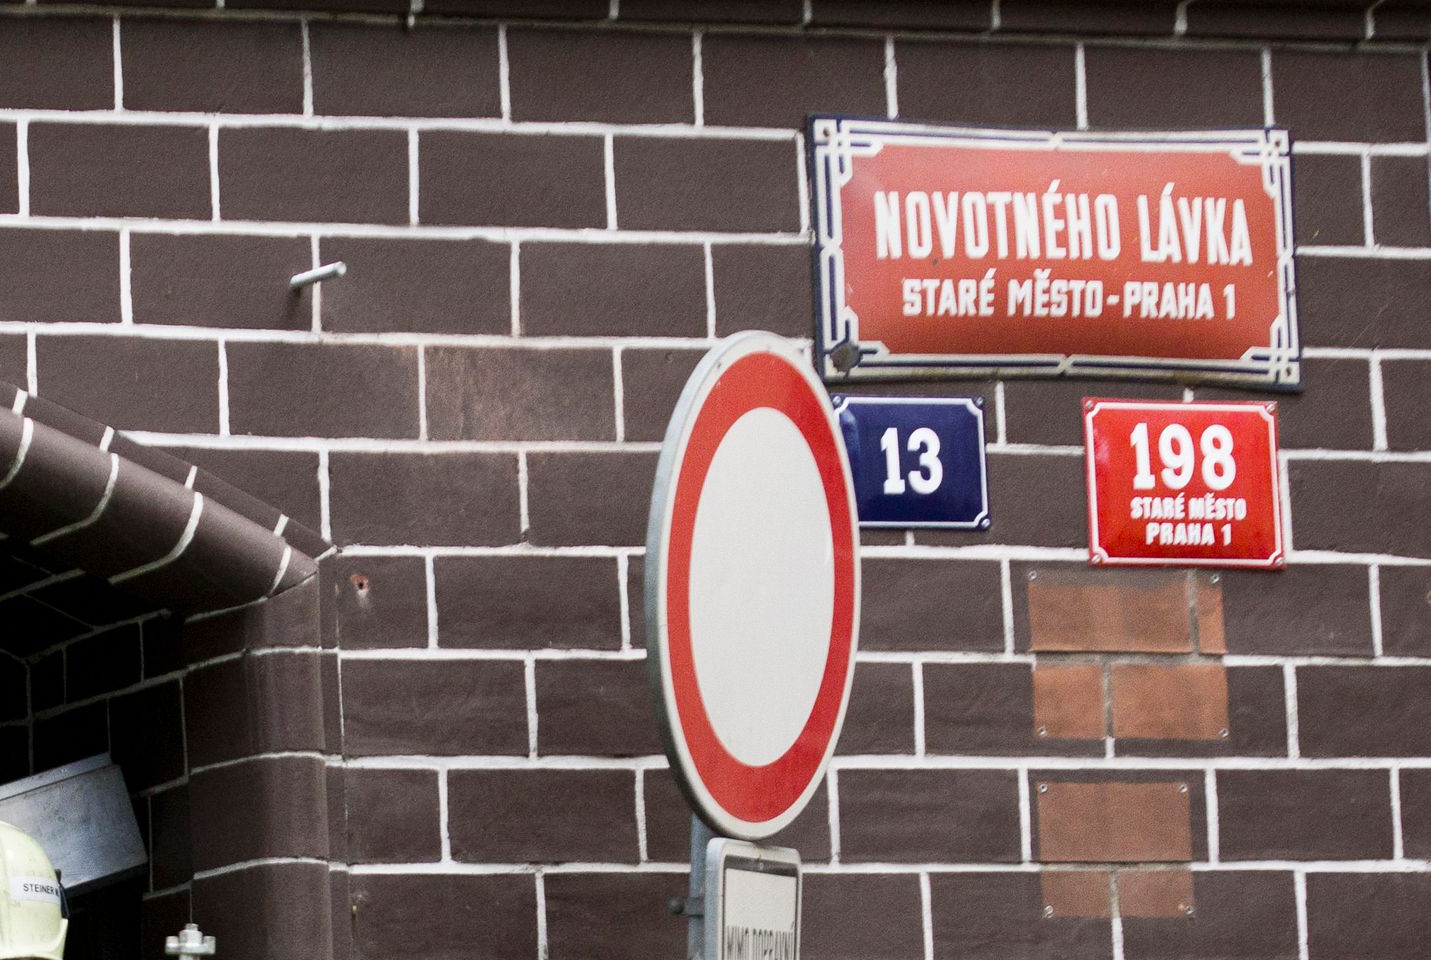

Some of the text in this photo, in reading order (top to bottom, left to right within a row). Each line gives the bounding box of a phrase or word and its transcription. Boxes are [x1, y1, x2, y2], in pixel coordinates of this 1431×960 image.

[874, 179, 1253, 266] NOVOTNÉHO LÁVKA
[902, 268, 996, 317] STARÉ
[1223, 283, 1236, 319] 1
[880, 427, 943, 495] 13
[1129, 422, 1236, 491] 198
[1130, 492, 1247, 520] STARÉ MĚSTO
[1146, 522, 1231, 546] PRAHA 1
[23, 883, 55, 895] STEINER
